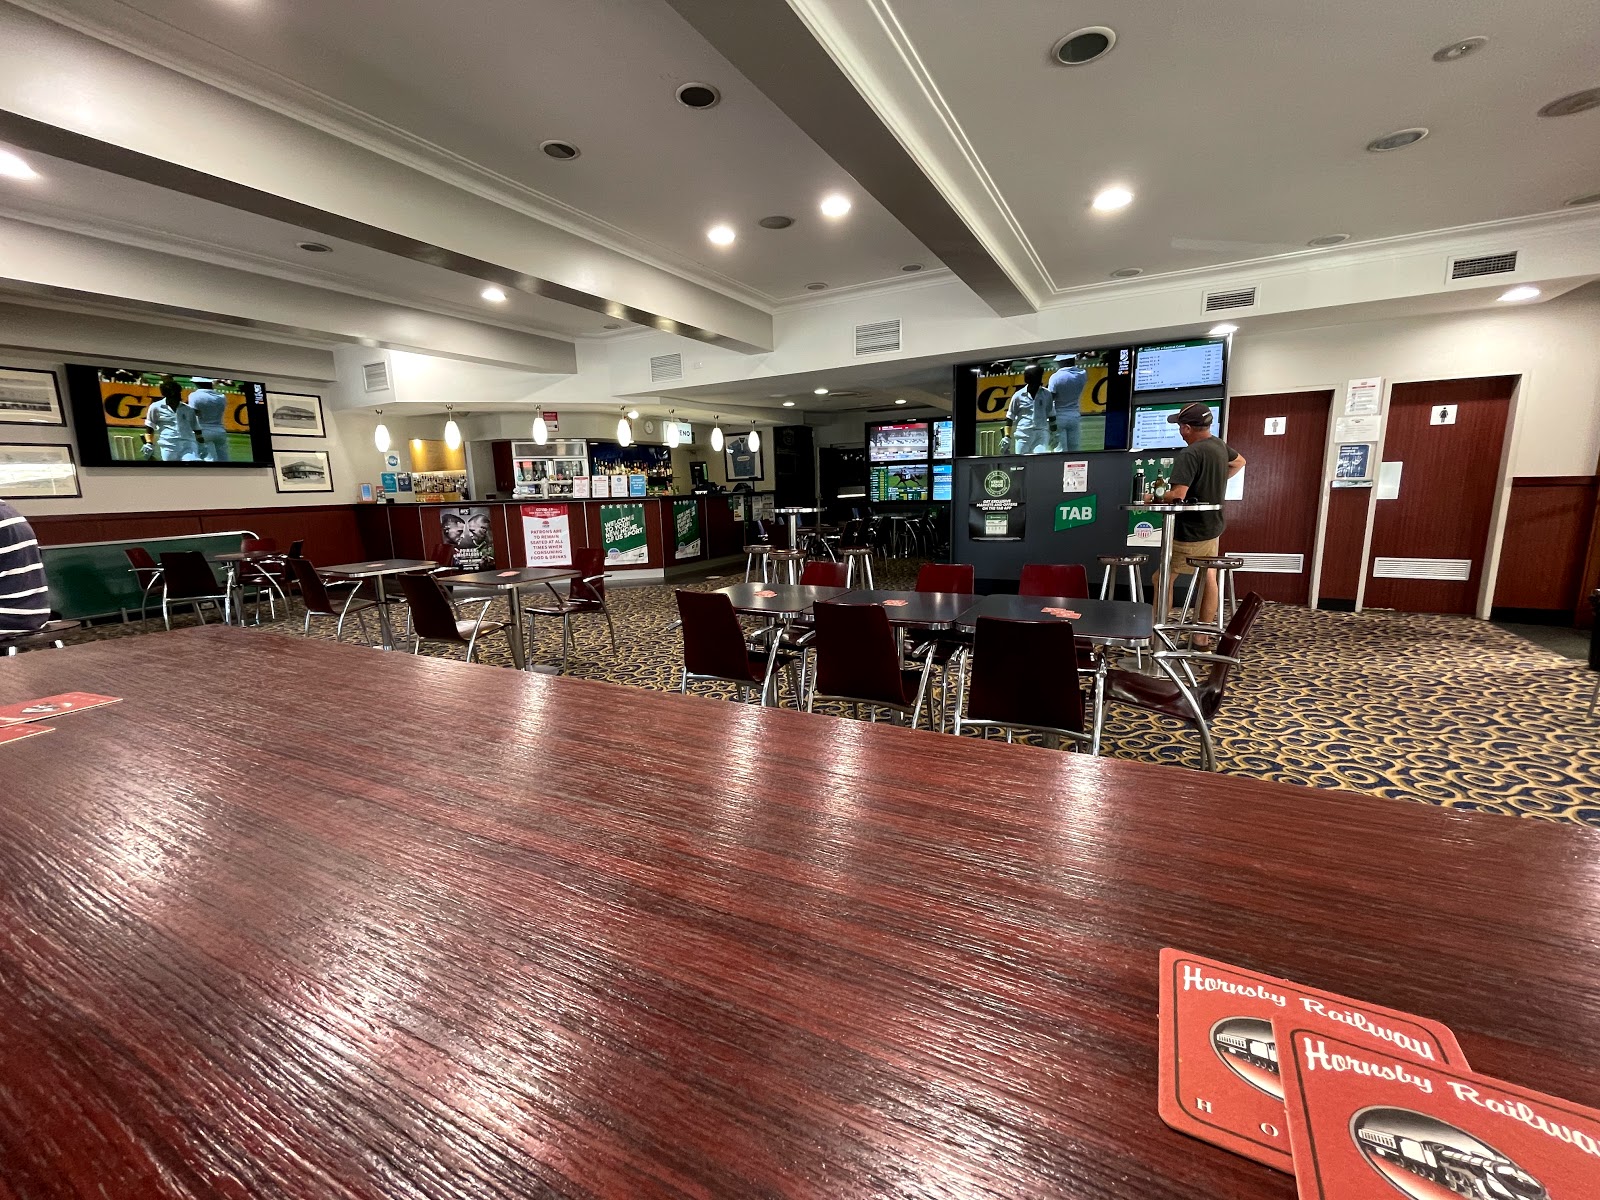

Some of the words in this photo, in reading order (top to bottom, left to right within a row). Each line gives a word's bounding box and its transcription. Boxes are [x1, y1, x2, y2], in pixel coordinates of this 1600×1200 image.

[1060, 506, 1092, 520] TAB
[604, 514, 635, 528] WELCOME
[614, 521, 630, 531] YOUR
[605, 529, 619, 538] NEW
[621, 523, 637, 534] HOME
[624, 527, 643, 538] SPORT
[1183, 964, 1287, 1007] Hornsby
[1298, 997, 1436, 1061] Railway
[1303, 1037, 1434, 1094] Hornsby
